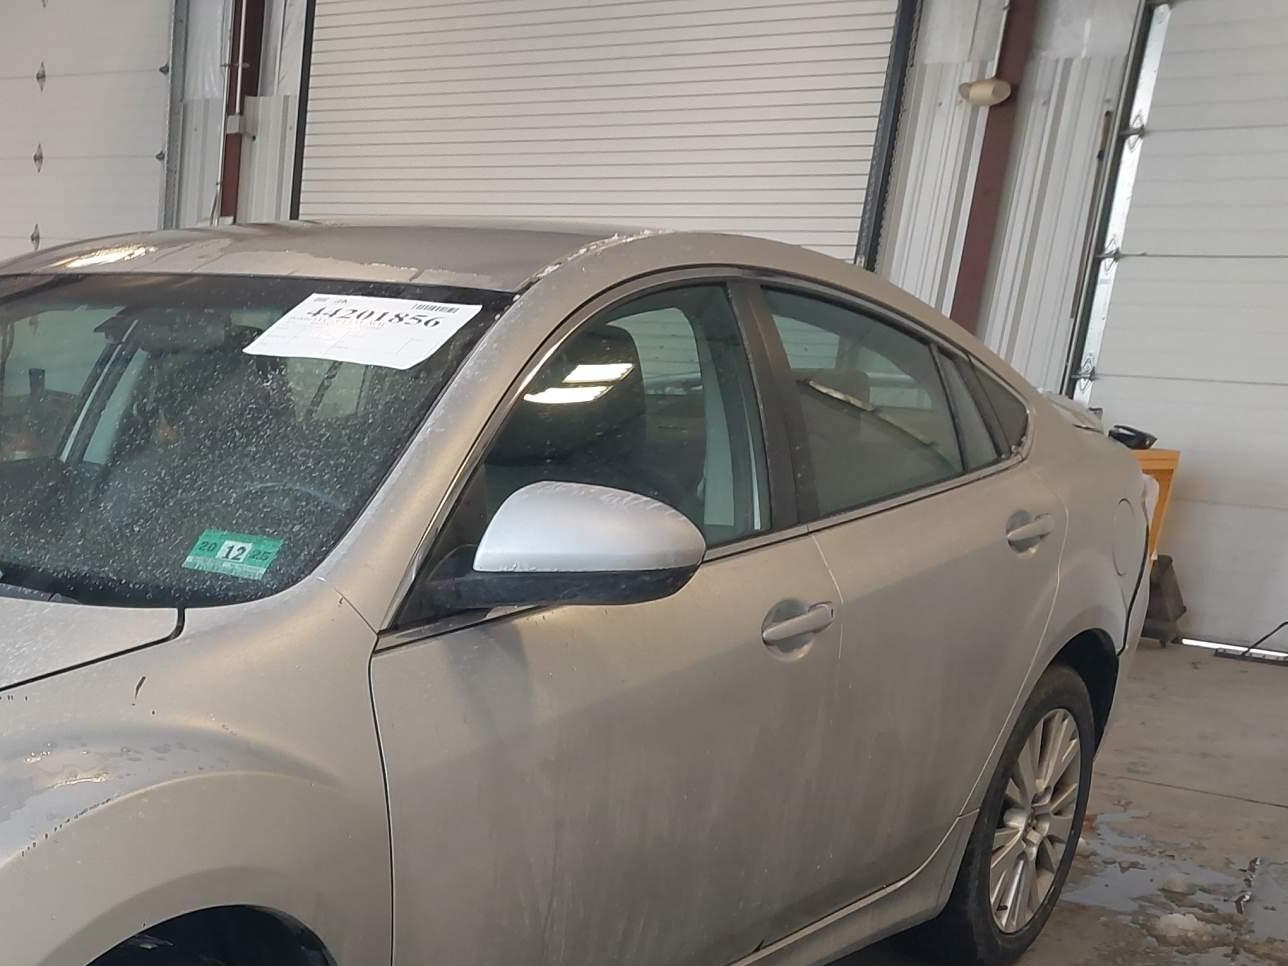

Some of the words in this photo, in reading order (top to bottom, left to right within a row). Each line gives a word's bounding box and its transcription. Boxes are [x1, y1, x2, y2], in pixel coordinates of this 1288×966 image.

[307, 306, 441, 328] 44201856
[199, 541, 217, 552] 20
[222, 544, 246, 561] 12
